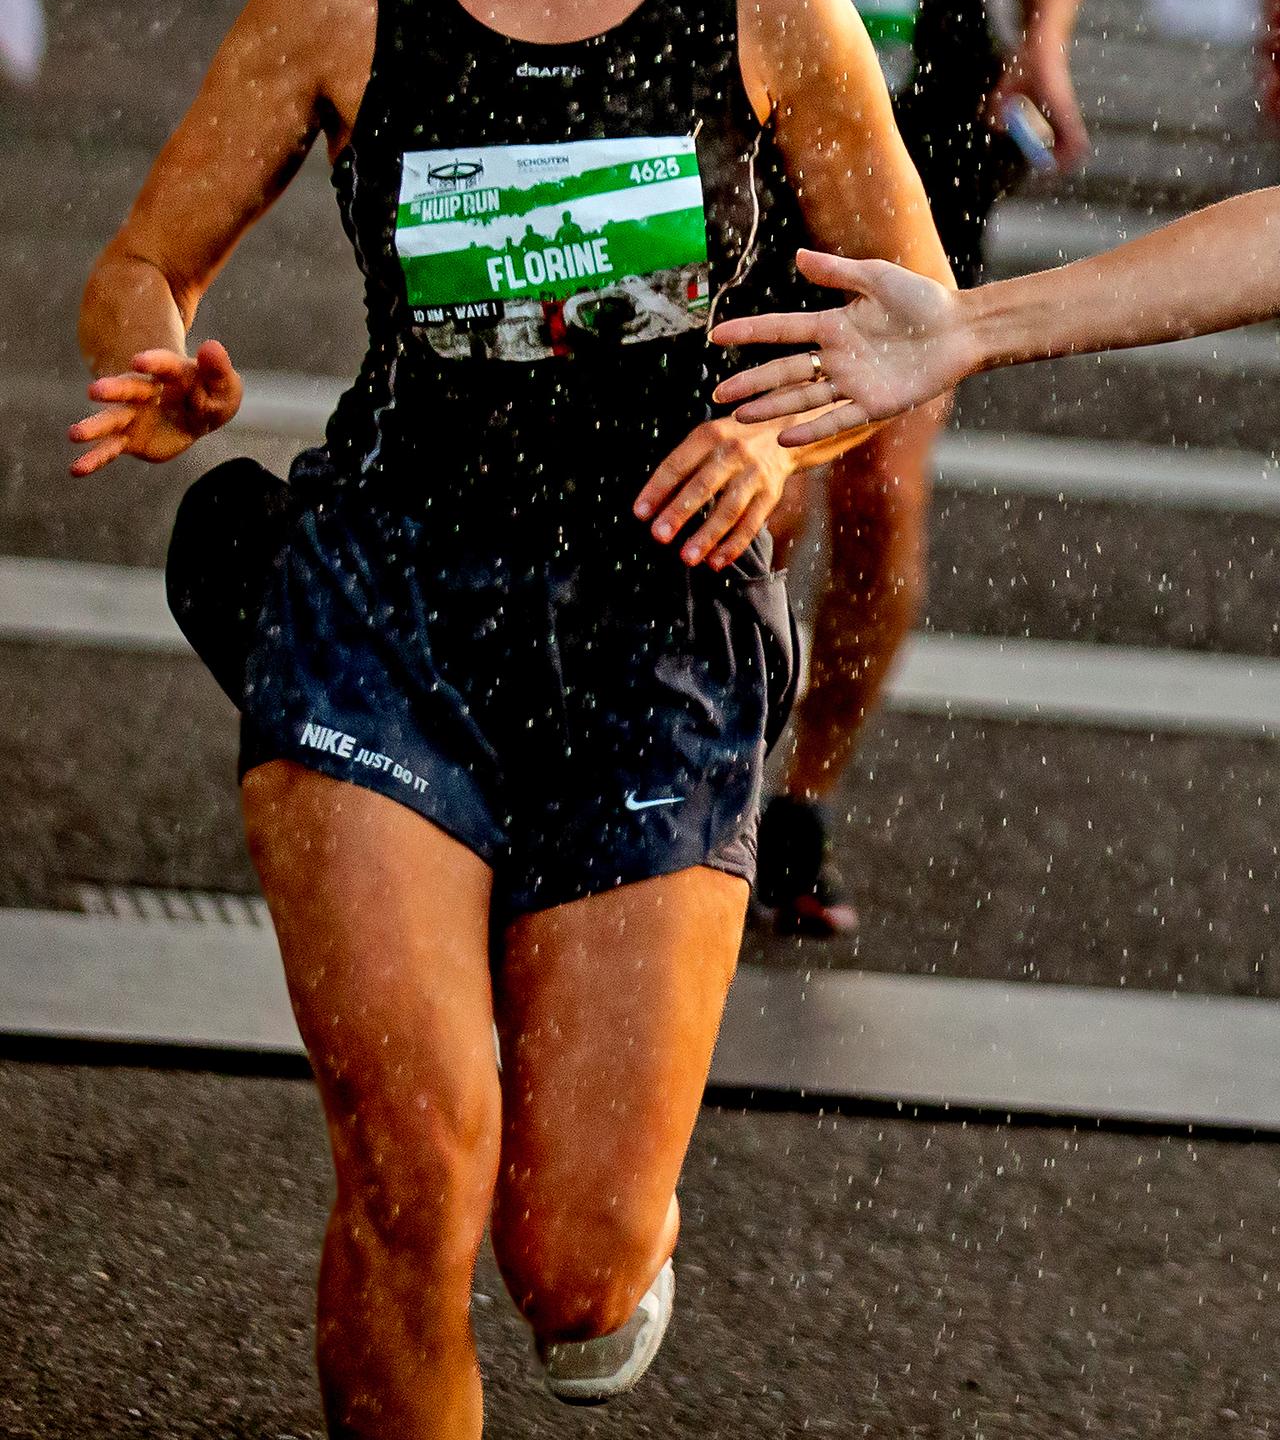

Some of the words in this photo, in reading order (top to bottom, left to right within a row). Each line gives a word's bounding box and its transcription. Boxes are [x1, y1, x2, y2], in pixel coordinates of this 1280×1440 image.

[630, 158, 681, 185] 4625
[421, 194, 461, 222] HUIP
[463, 188, 500, 215] RUN
[486, 238, 614, 292] FLORINE
[454, 302, 490, 320] WAVE
[301, 723, 357, 759] NIKE
[354, 748, 393, 770] JUST
[391, 763, 415, 785] DO
[414, 776, 431, 794] IT
